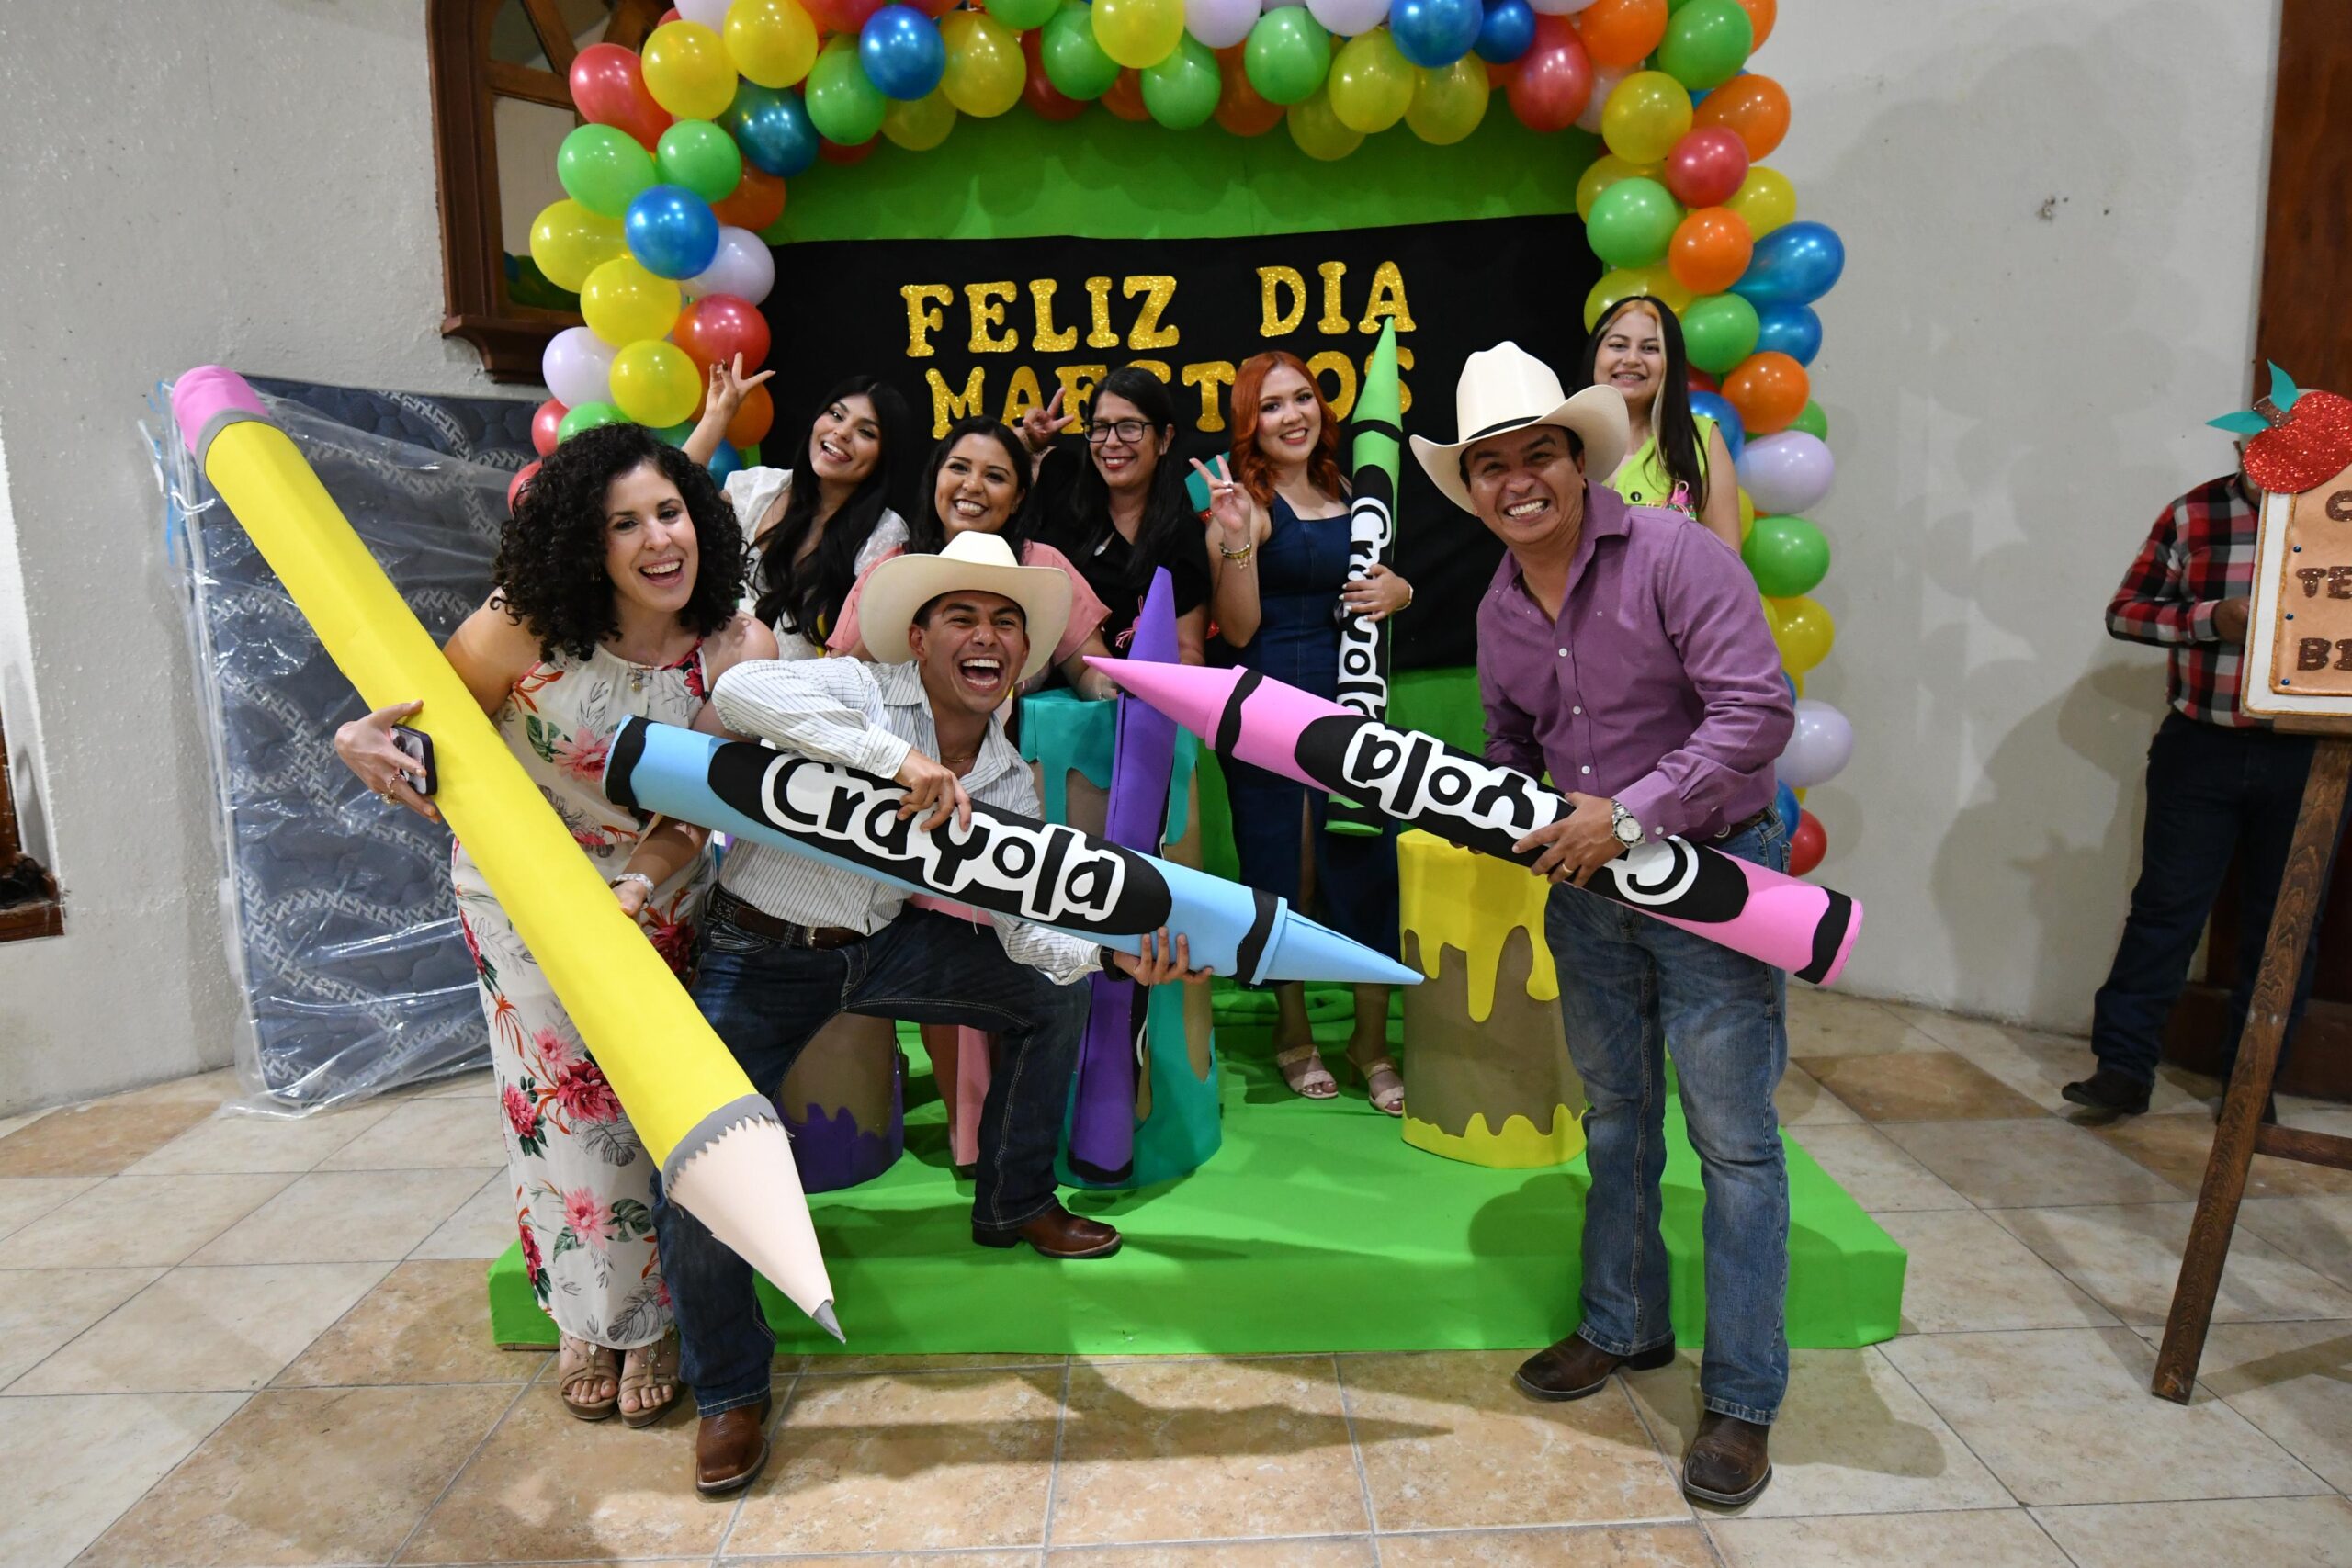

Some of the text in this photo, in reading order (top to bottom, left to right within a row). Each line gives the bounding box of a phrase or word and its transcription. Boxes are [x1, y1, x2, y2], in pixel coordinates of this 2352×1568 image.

[900, 260, 1417, 357] FELIZ DIA
[925, 346, 1415, 440] MAETO
[772, 755, 1117, 917] Crayola
[1350, 733, 1689, 896] Cyola
